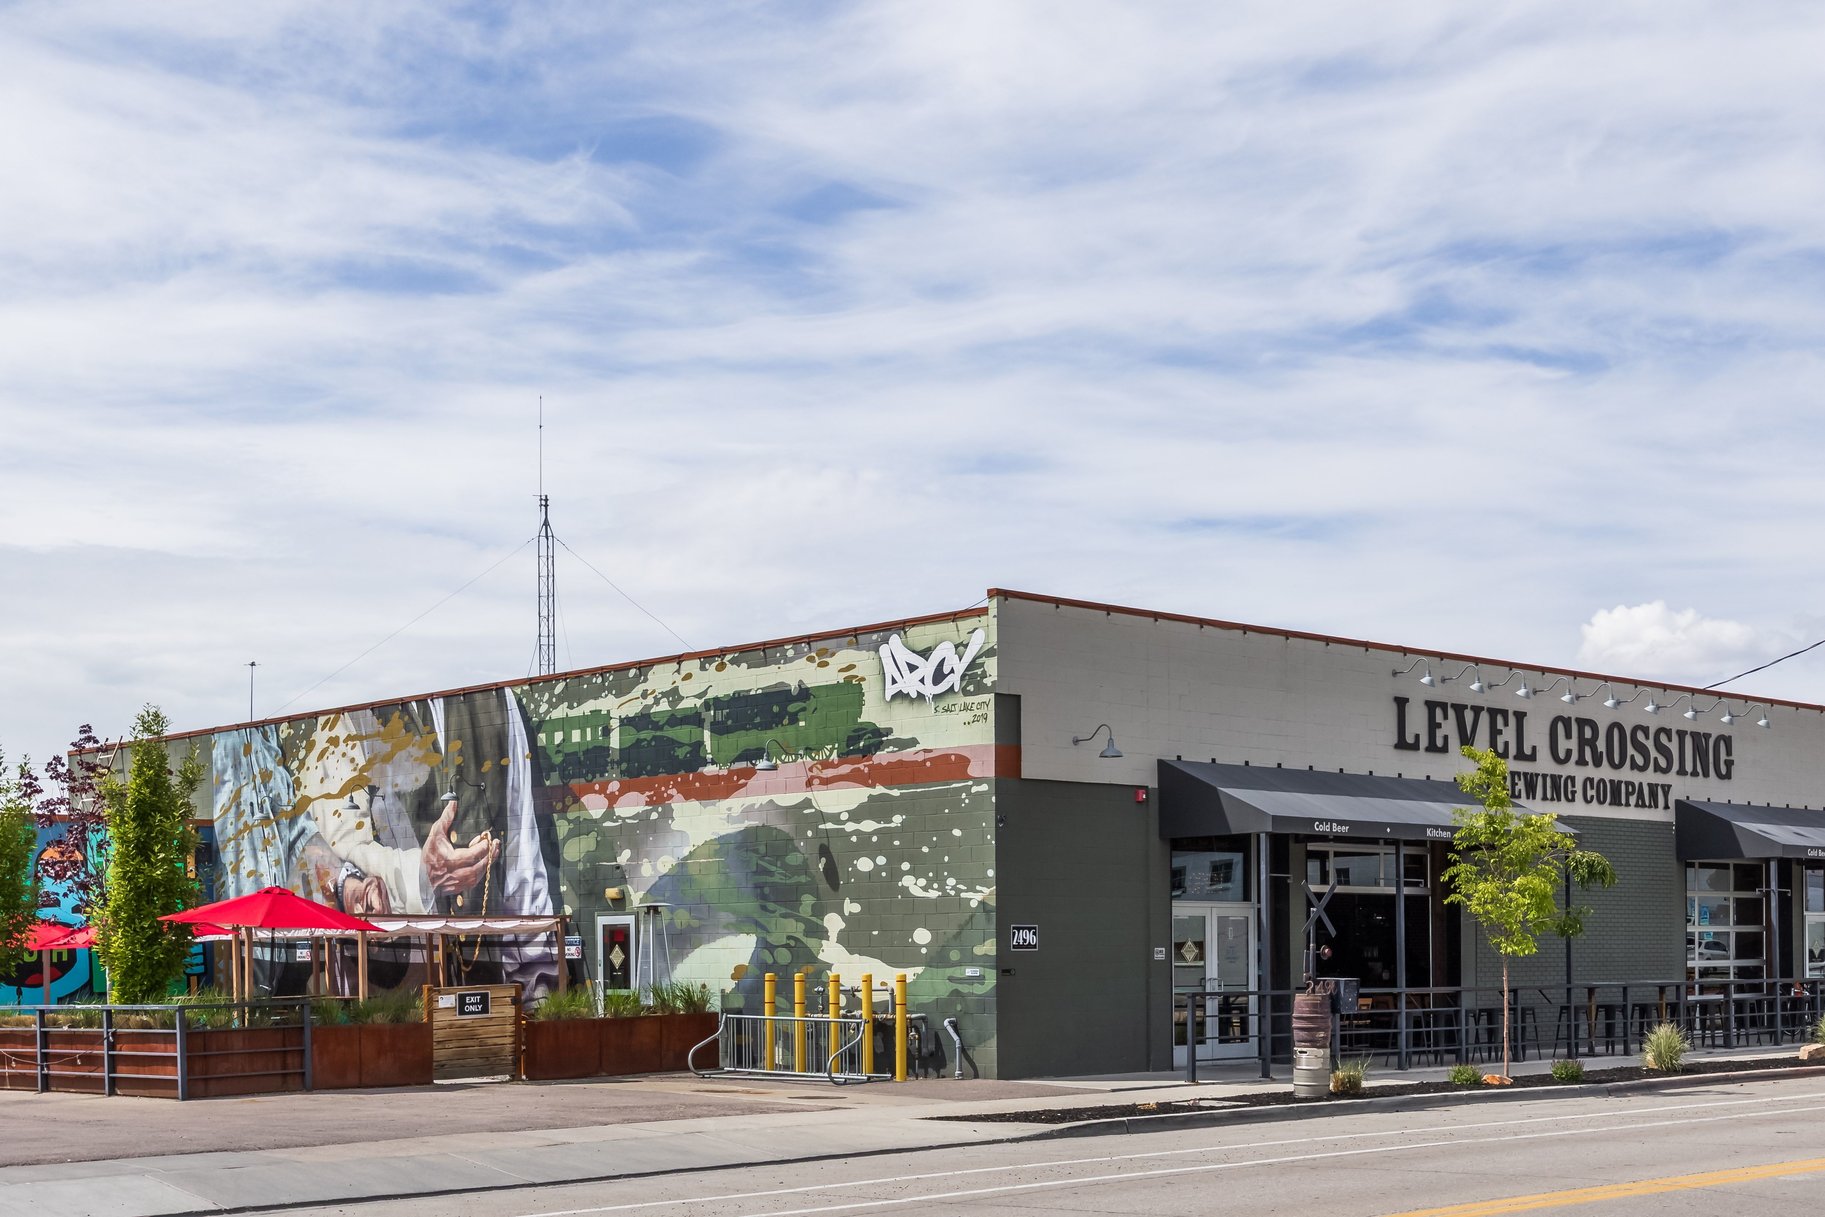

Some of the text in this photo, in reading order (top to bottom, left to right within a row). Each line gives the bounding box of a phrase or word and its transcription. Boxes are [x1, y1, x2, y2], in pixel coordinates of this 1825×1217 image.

[941, 703, 958, 713] SALT
[959, 701, 975, 712] LAKE
[976, 698, 991, 711] CITY
[1394, 696, 1735, 780] LEVEL CROSSING
[1502, 770, 1673, 810] EWING COMPANY
[1314, 821, 1349, 833] Cold Beer
[1426, 828, 1451, 838] Kitchen
[1807, 848, 1817, 857] Cold
[1012, 929, 1037, 946] 2496
[466, 996, 481, 1004] EXIT
[464, 1004, 483, 1012] ONLY
